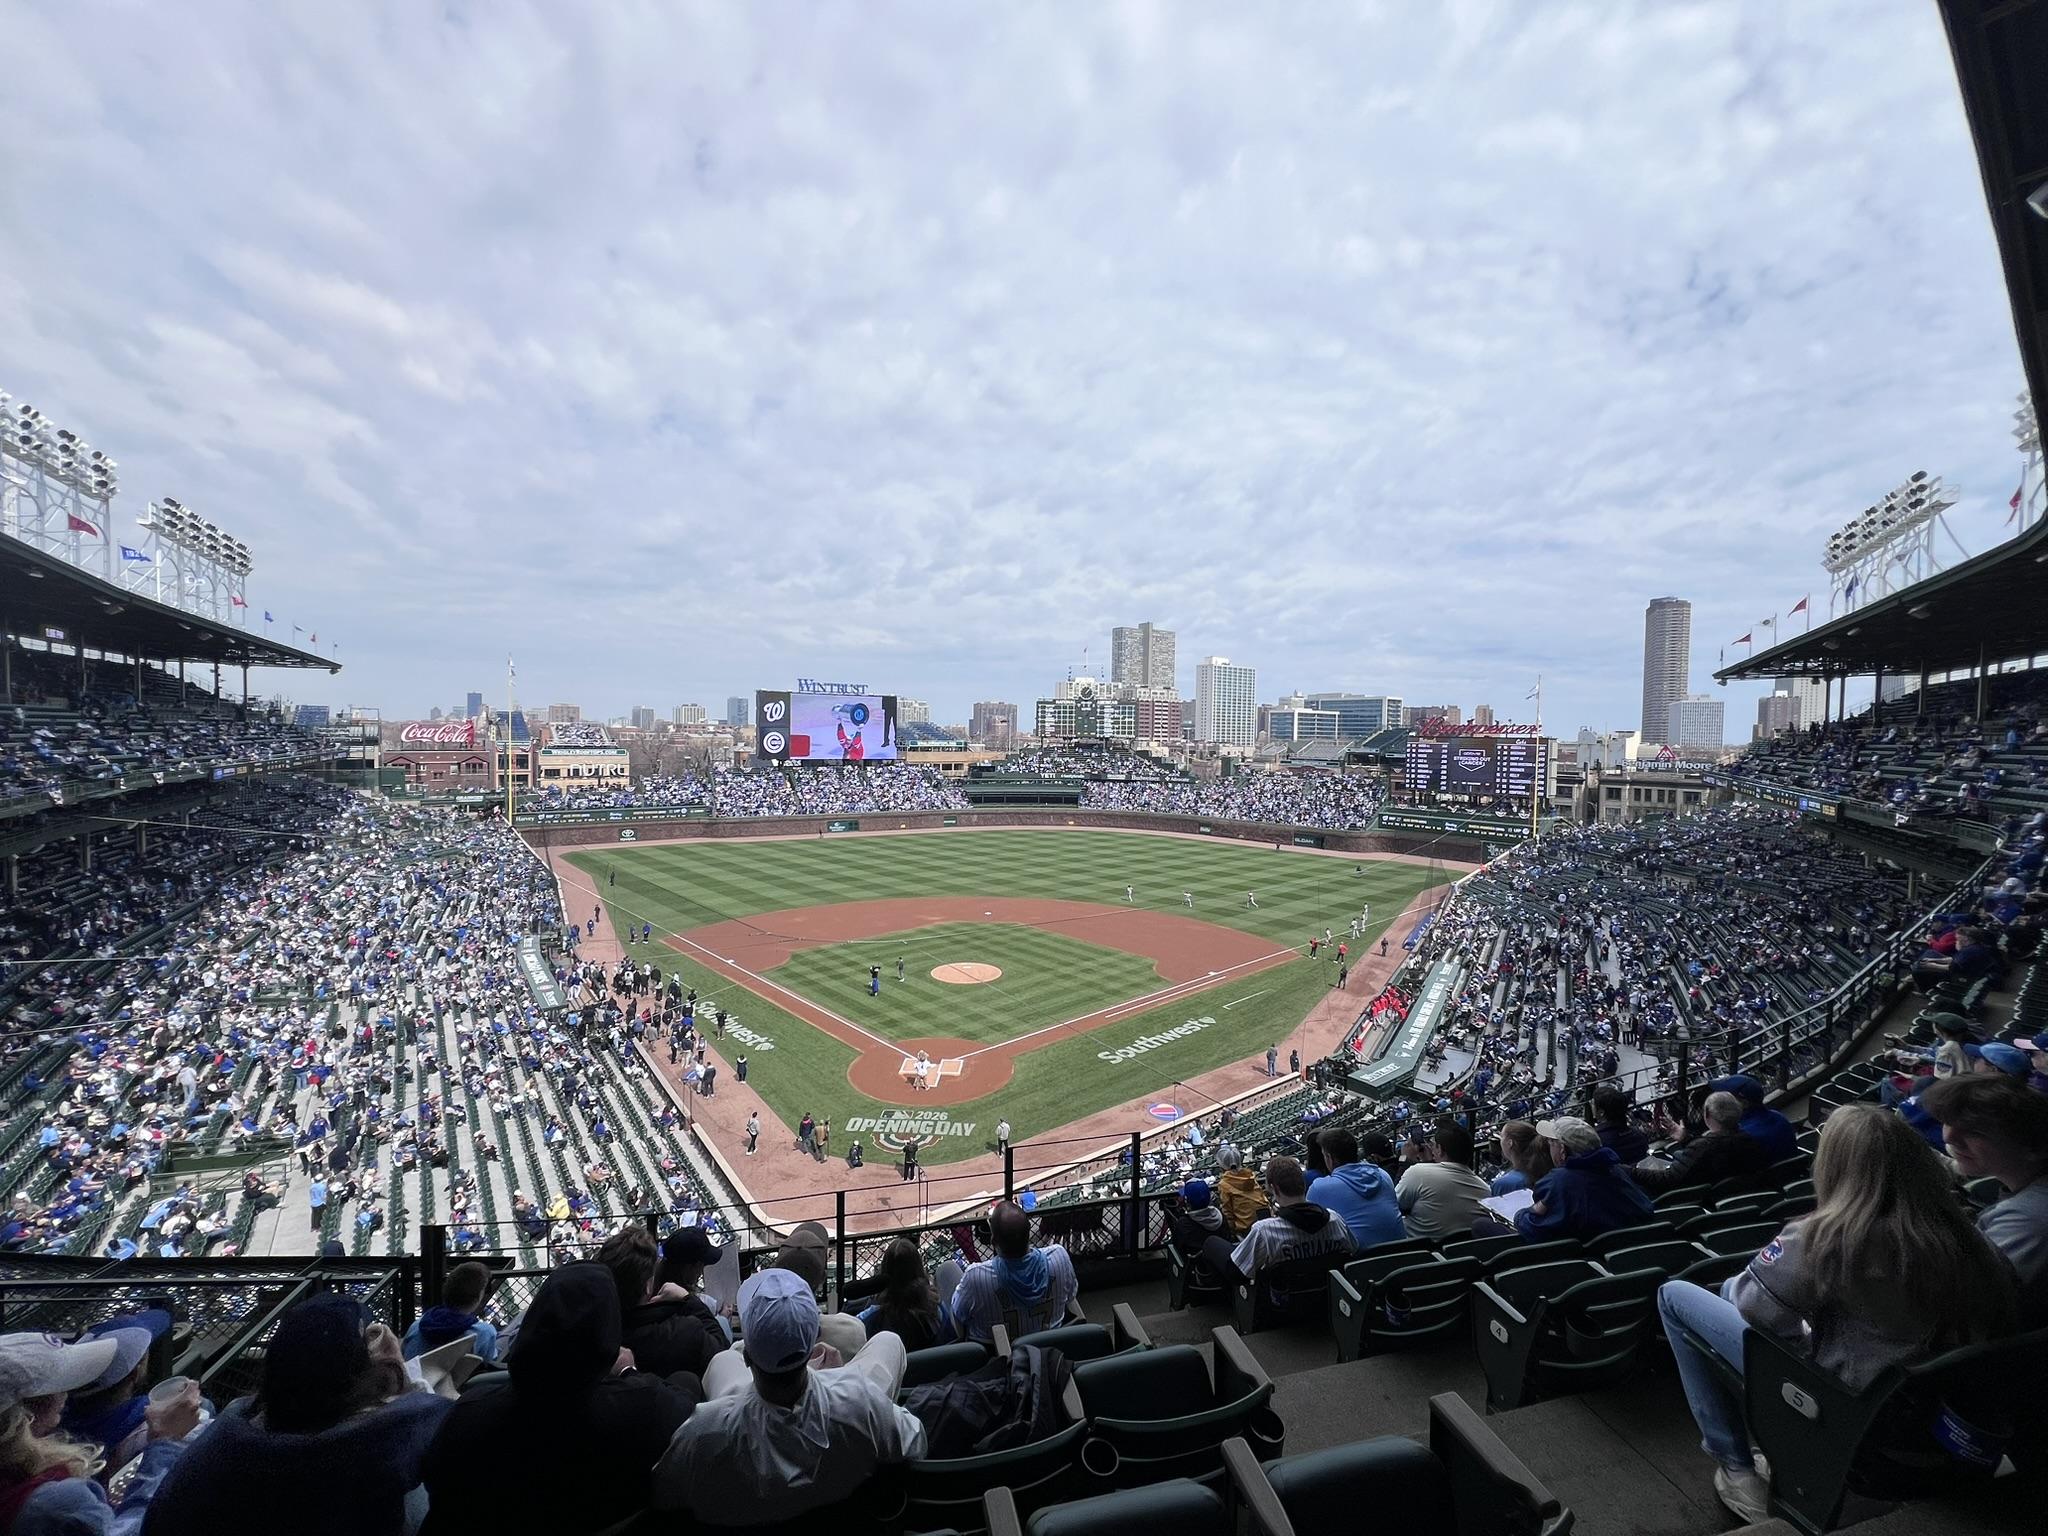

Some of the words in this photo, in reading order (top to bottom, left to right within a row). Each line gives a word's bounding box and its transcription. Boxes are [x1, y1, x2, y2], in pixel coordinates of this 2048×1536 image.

[797, 678, 869, 695] WINTRUST
[1675, 761, 1712, 771] Moore
[1098, 1017, 1211, 1064] Southwest
[915, 1110, 949, 1121] 2026
[845, 1117, 933, 1135] OPENING
[934, 1120, 976, 1136] DAY
[1792, 1391, 1805, 1408] 5
